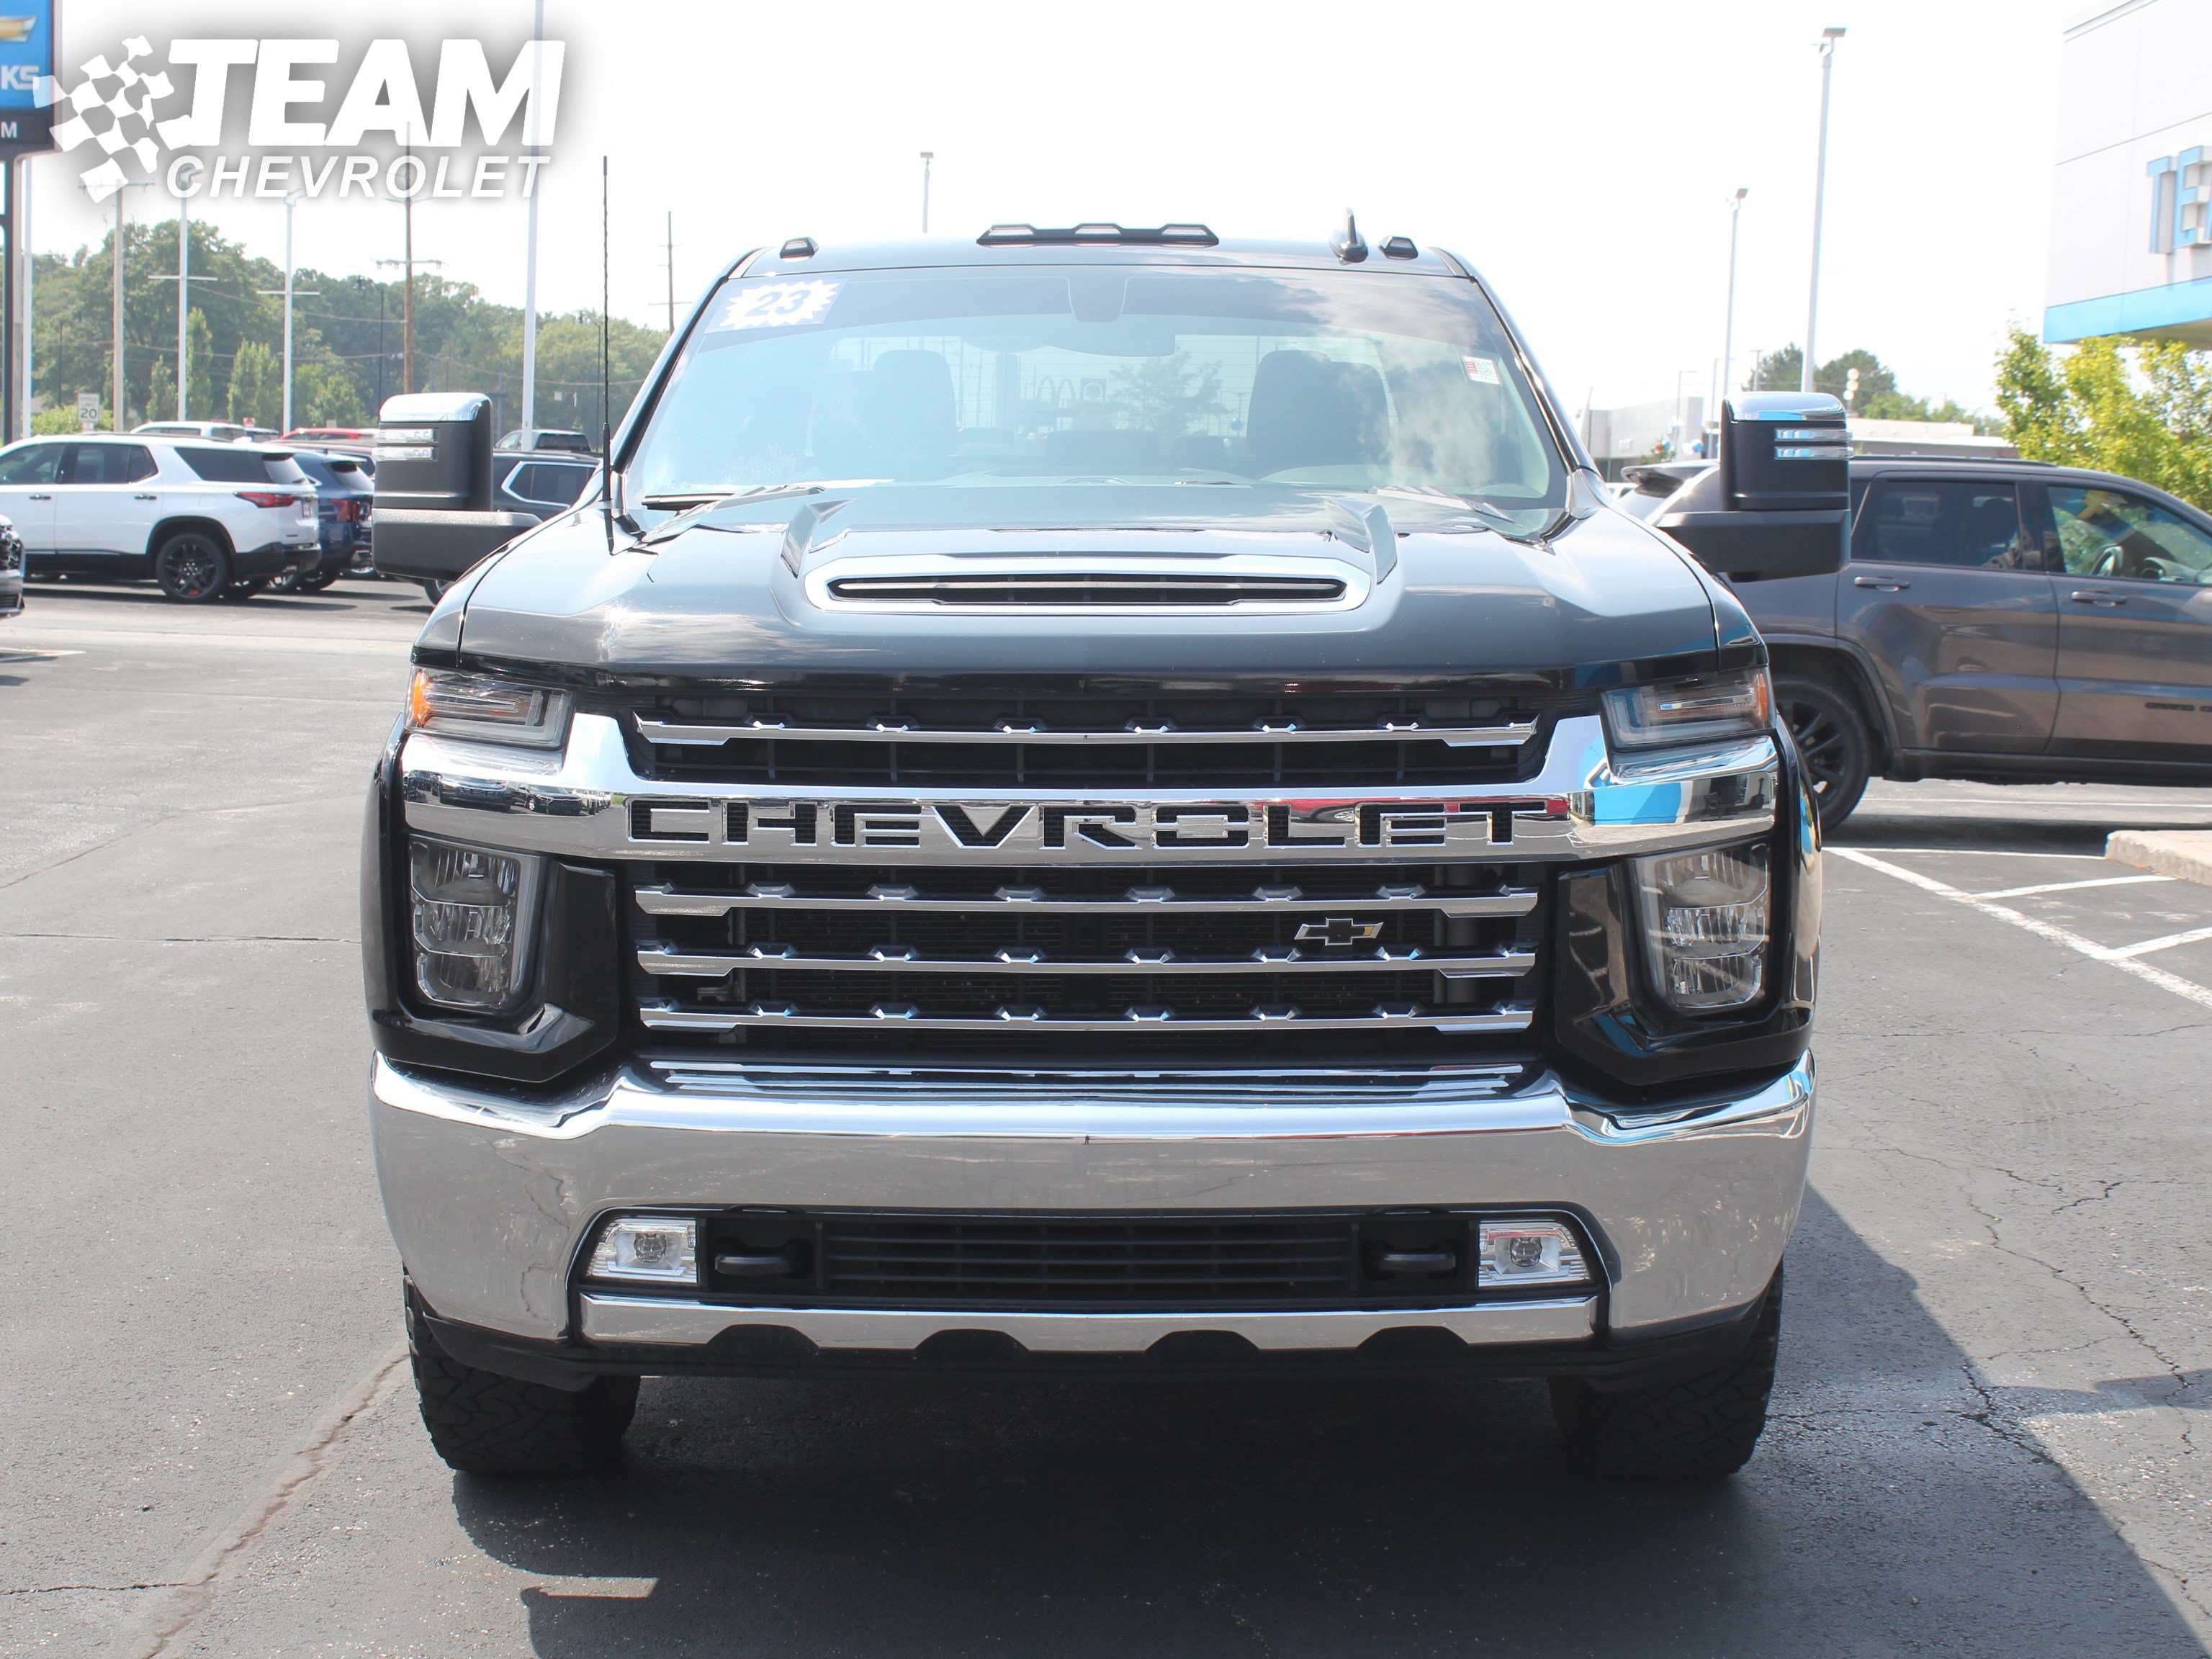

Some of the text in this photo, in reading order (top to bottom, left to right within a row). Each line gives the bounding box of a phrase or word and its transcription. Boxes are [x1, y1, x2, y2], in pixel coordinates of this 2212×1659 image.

[2146, 145, 2212, 253] TE
[744, 289, 811, 317] 23
[80, 408, 97, 419] 20
[627, 799, 1548, 850] CHEVROLET
